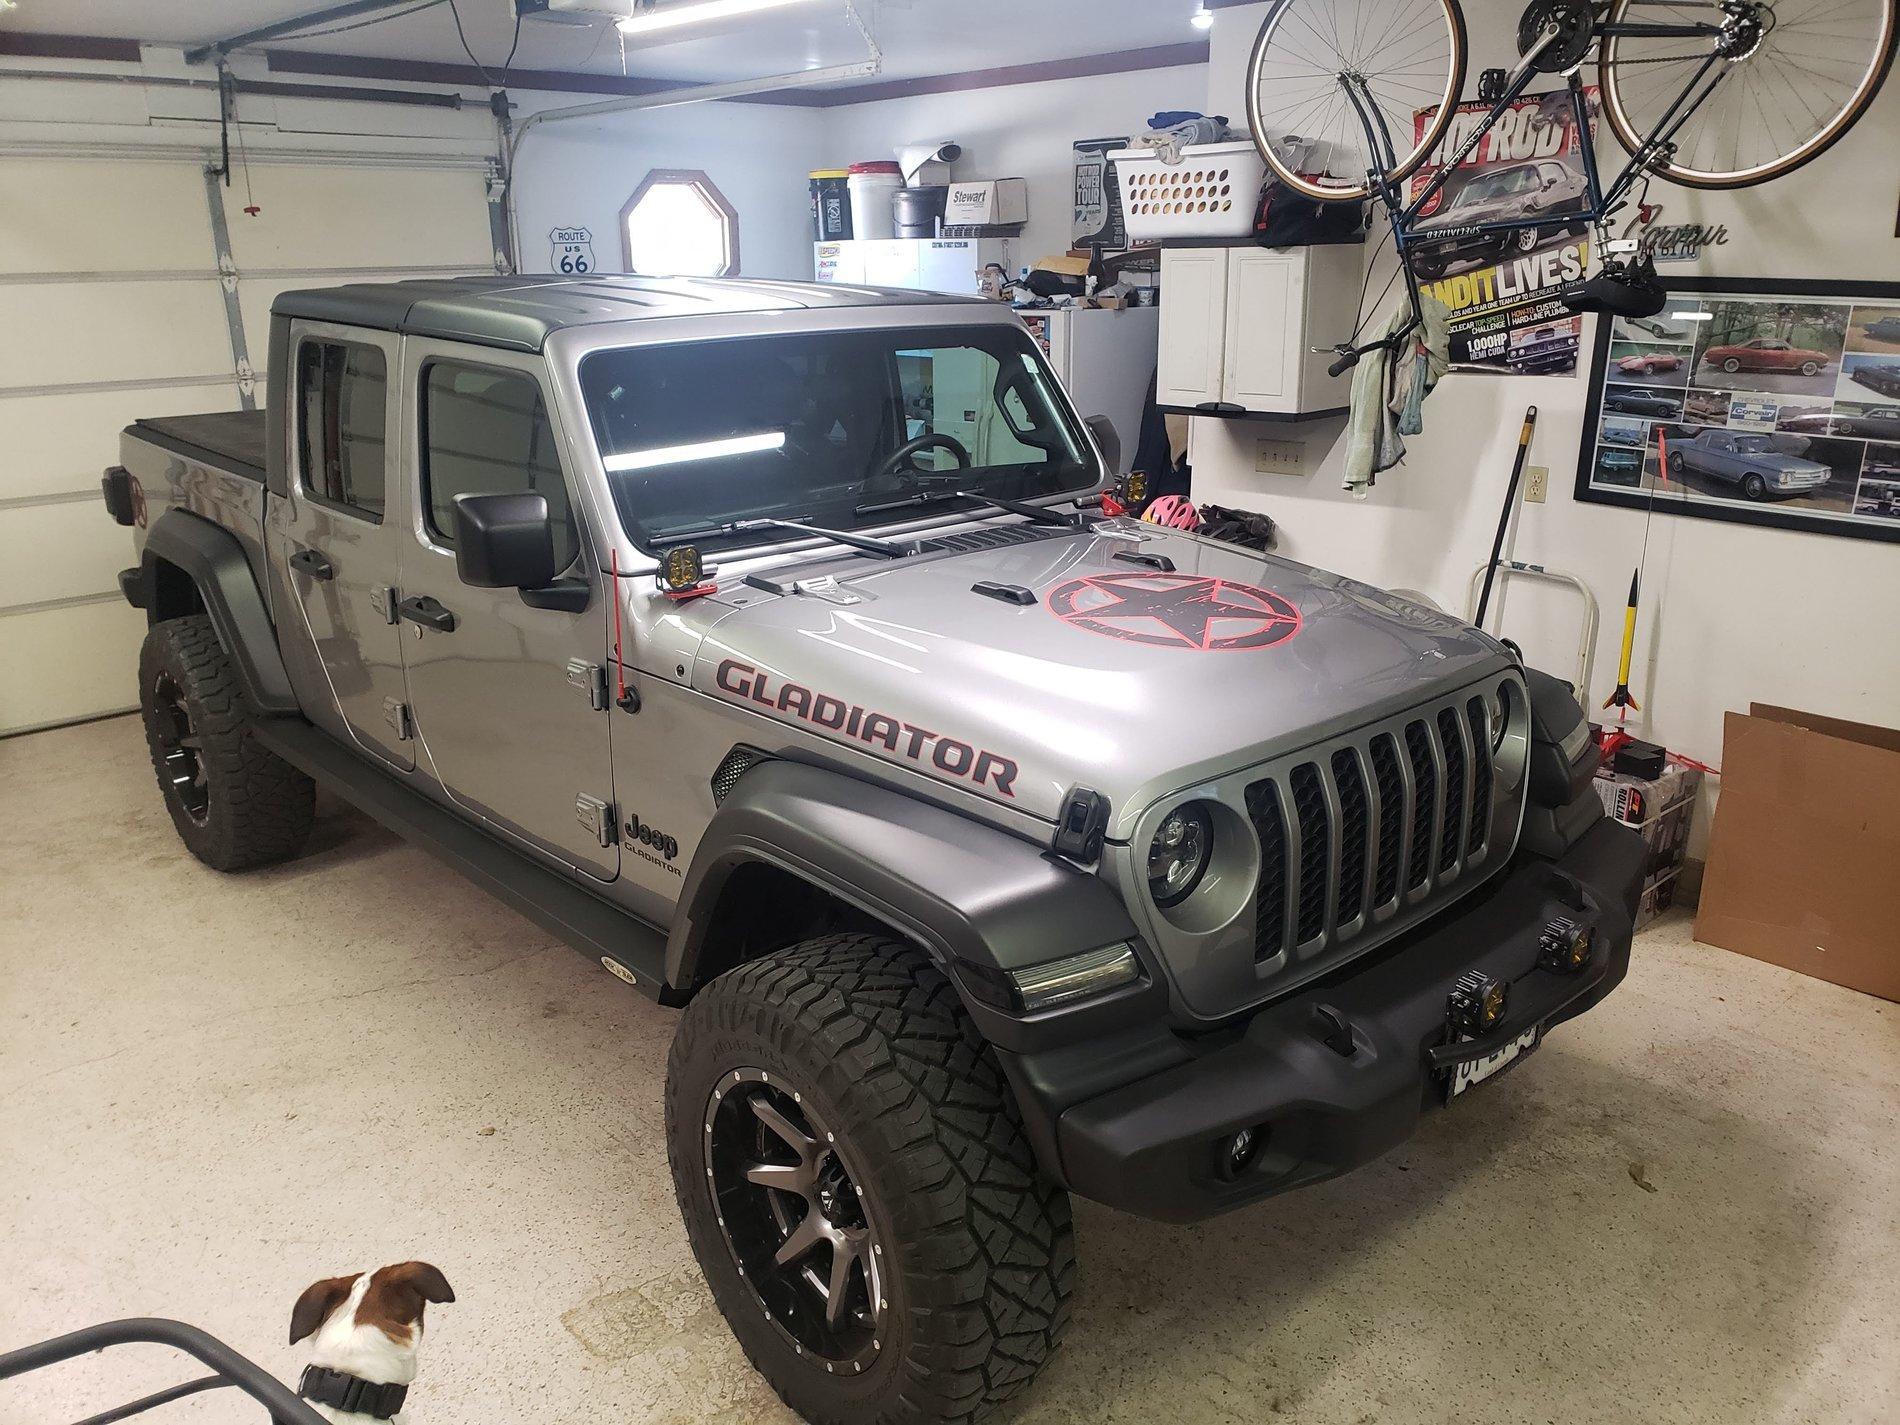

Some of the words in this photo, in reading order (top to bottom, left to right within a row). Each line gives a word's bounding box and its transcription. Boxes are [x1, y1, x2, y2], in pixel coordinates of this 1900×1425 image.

[1486, 105, 1565, 162] ROD
[1076, 175, 1099, 189] POWER
[953, 189, 986, 204] Stewart
[1076, 187, 1099, 205] TOUR
[558, 232, 585, 241] ROUTE
[1426, 225, 1482, 239] SPECIALIZED
[560, 254, 588, 274] 66
[1420, 267, 1497, 311] ANDIT
[1496, 242, 1588, 298] LIVES!
[1462, 308, 1474, 316] AND
[1473, 304, 1487, 314] YEAR
[1487, 302, 1498, 311] ONE
[1498, 298, 1513, 308] TEAM
[1513, 296, 1522, 304] UP
[1522, 294, 1529, 302] TO
[1529, 287, 1556, 297] RECREATE
[1536, 300, 1562, 313] CUSTOM
[1512, 312, 1544, 325] HARD-LINE
[1472, 321, 1506, 335] CHALLENGE
[1467, 332, 1508, 352] 1,000HP
[1469, 350, 1487, 361] HEMI
[1487, 346, 1506, 357] CUDA
[1735, 407, 1773, 416] Corvair
[714, 658, 1019, 798] GLADIATOR
[1615, 788, 1628, 821] ROLLIN
[625, 813, 678, 861] Jeep
[624, 841, 682, 878] GLADIATOR
